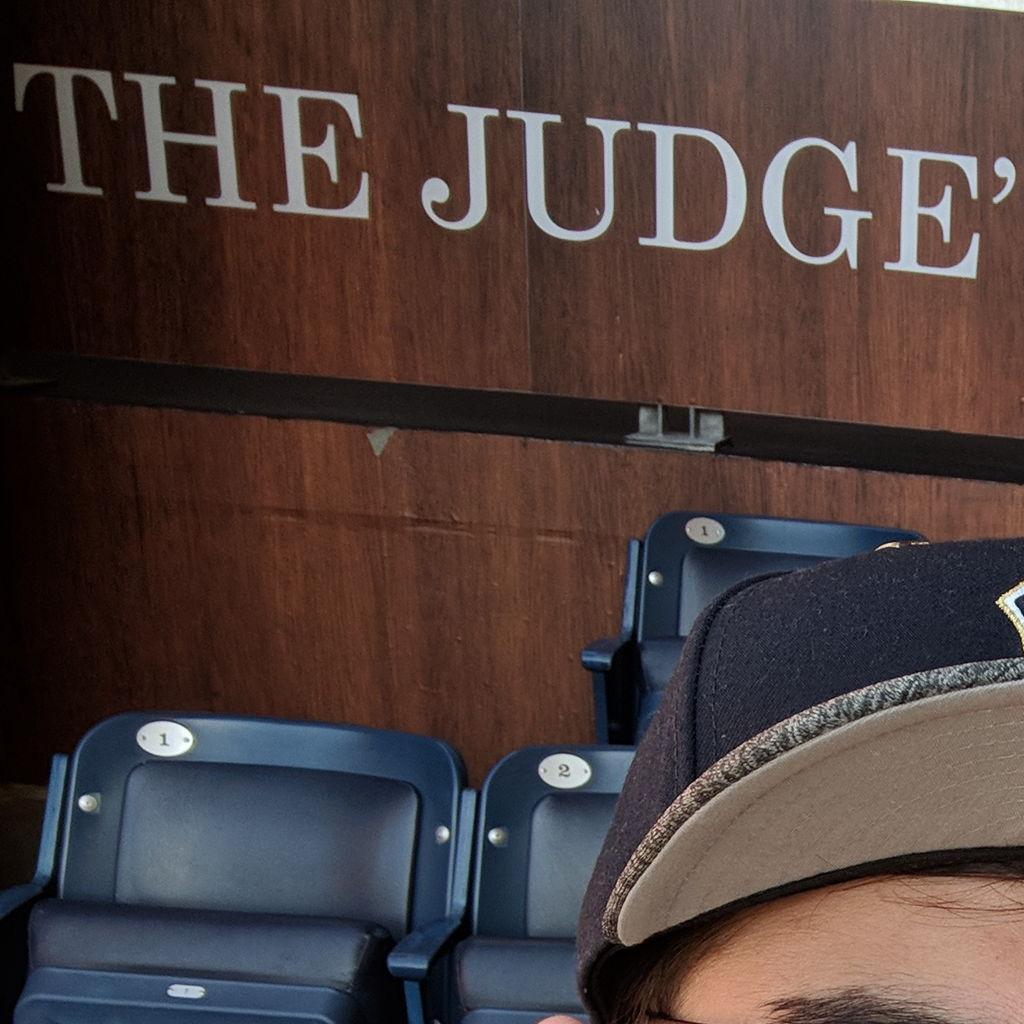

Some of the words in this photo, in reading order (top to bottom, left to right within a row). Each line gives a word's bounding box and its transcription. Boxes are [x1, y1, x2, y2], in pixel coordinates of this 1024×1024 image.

[13, 63, 370, 220] THE
[159, 733, 170, 747] 1
[558, 763, 570, 778] 2
